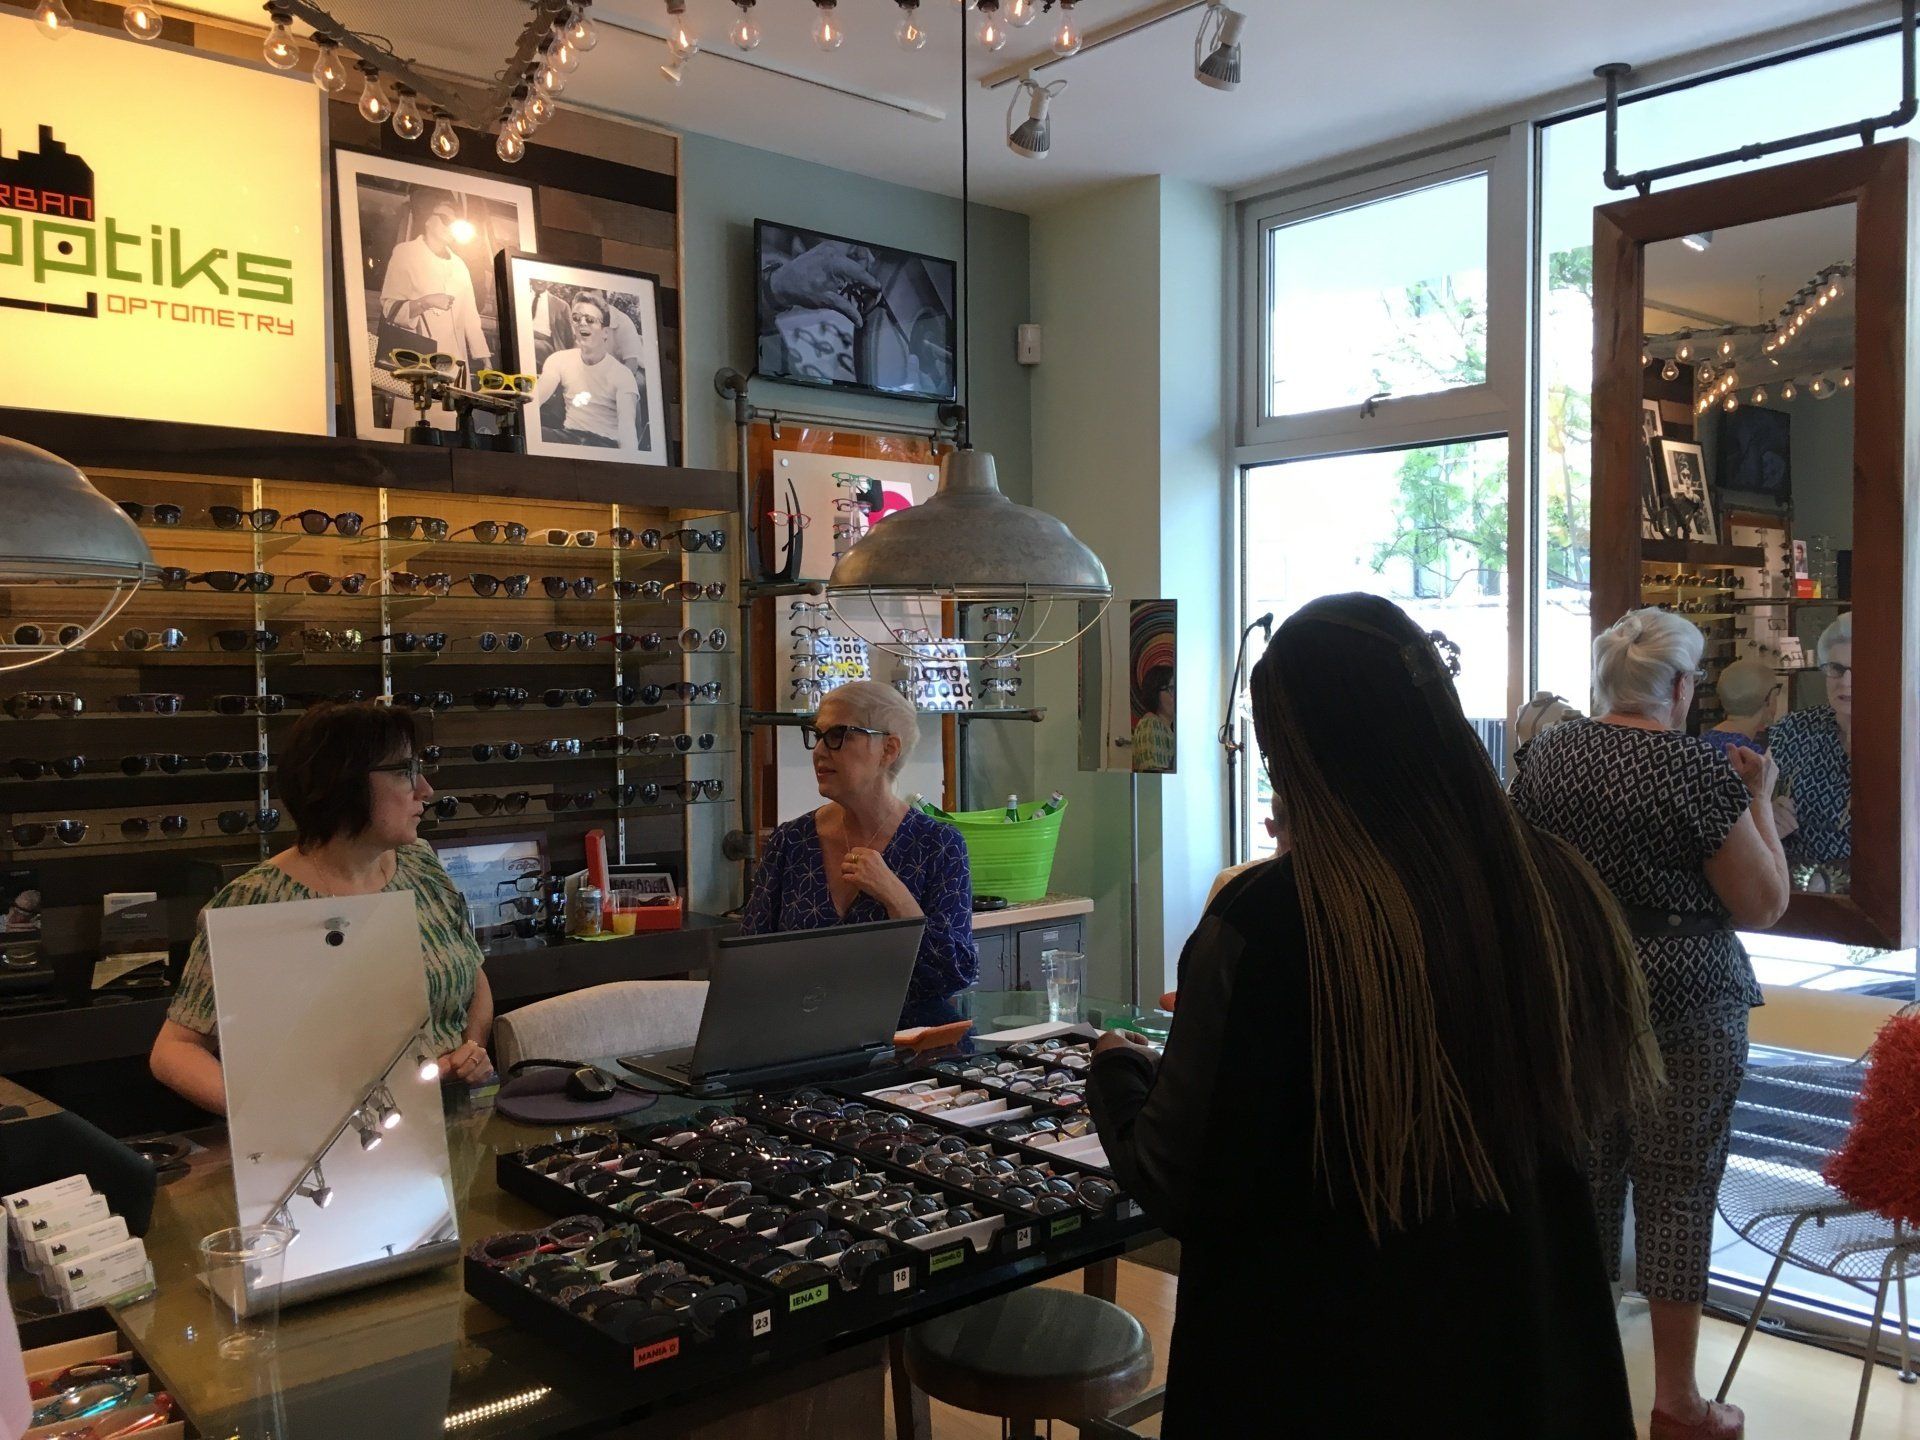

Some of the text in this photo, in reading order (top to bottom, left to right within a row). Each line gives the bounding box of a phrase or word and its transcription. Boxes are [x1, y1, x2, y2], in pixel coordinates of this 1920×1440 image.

[107, 294, 294, 336] OPTOMETRY
[1018, 1230, 1029, 1241] 24
[895, 1270, 907, 1282] 18
[792, 1293, 815, 1307] IENA
[754, 1316, 769, 1330] 23
[638, 1346, 667, 1363] MANIA
